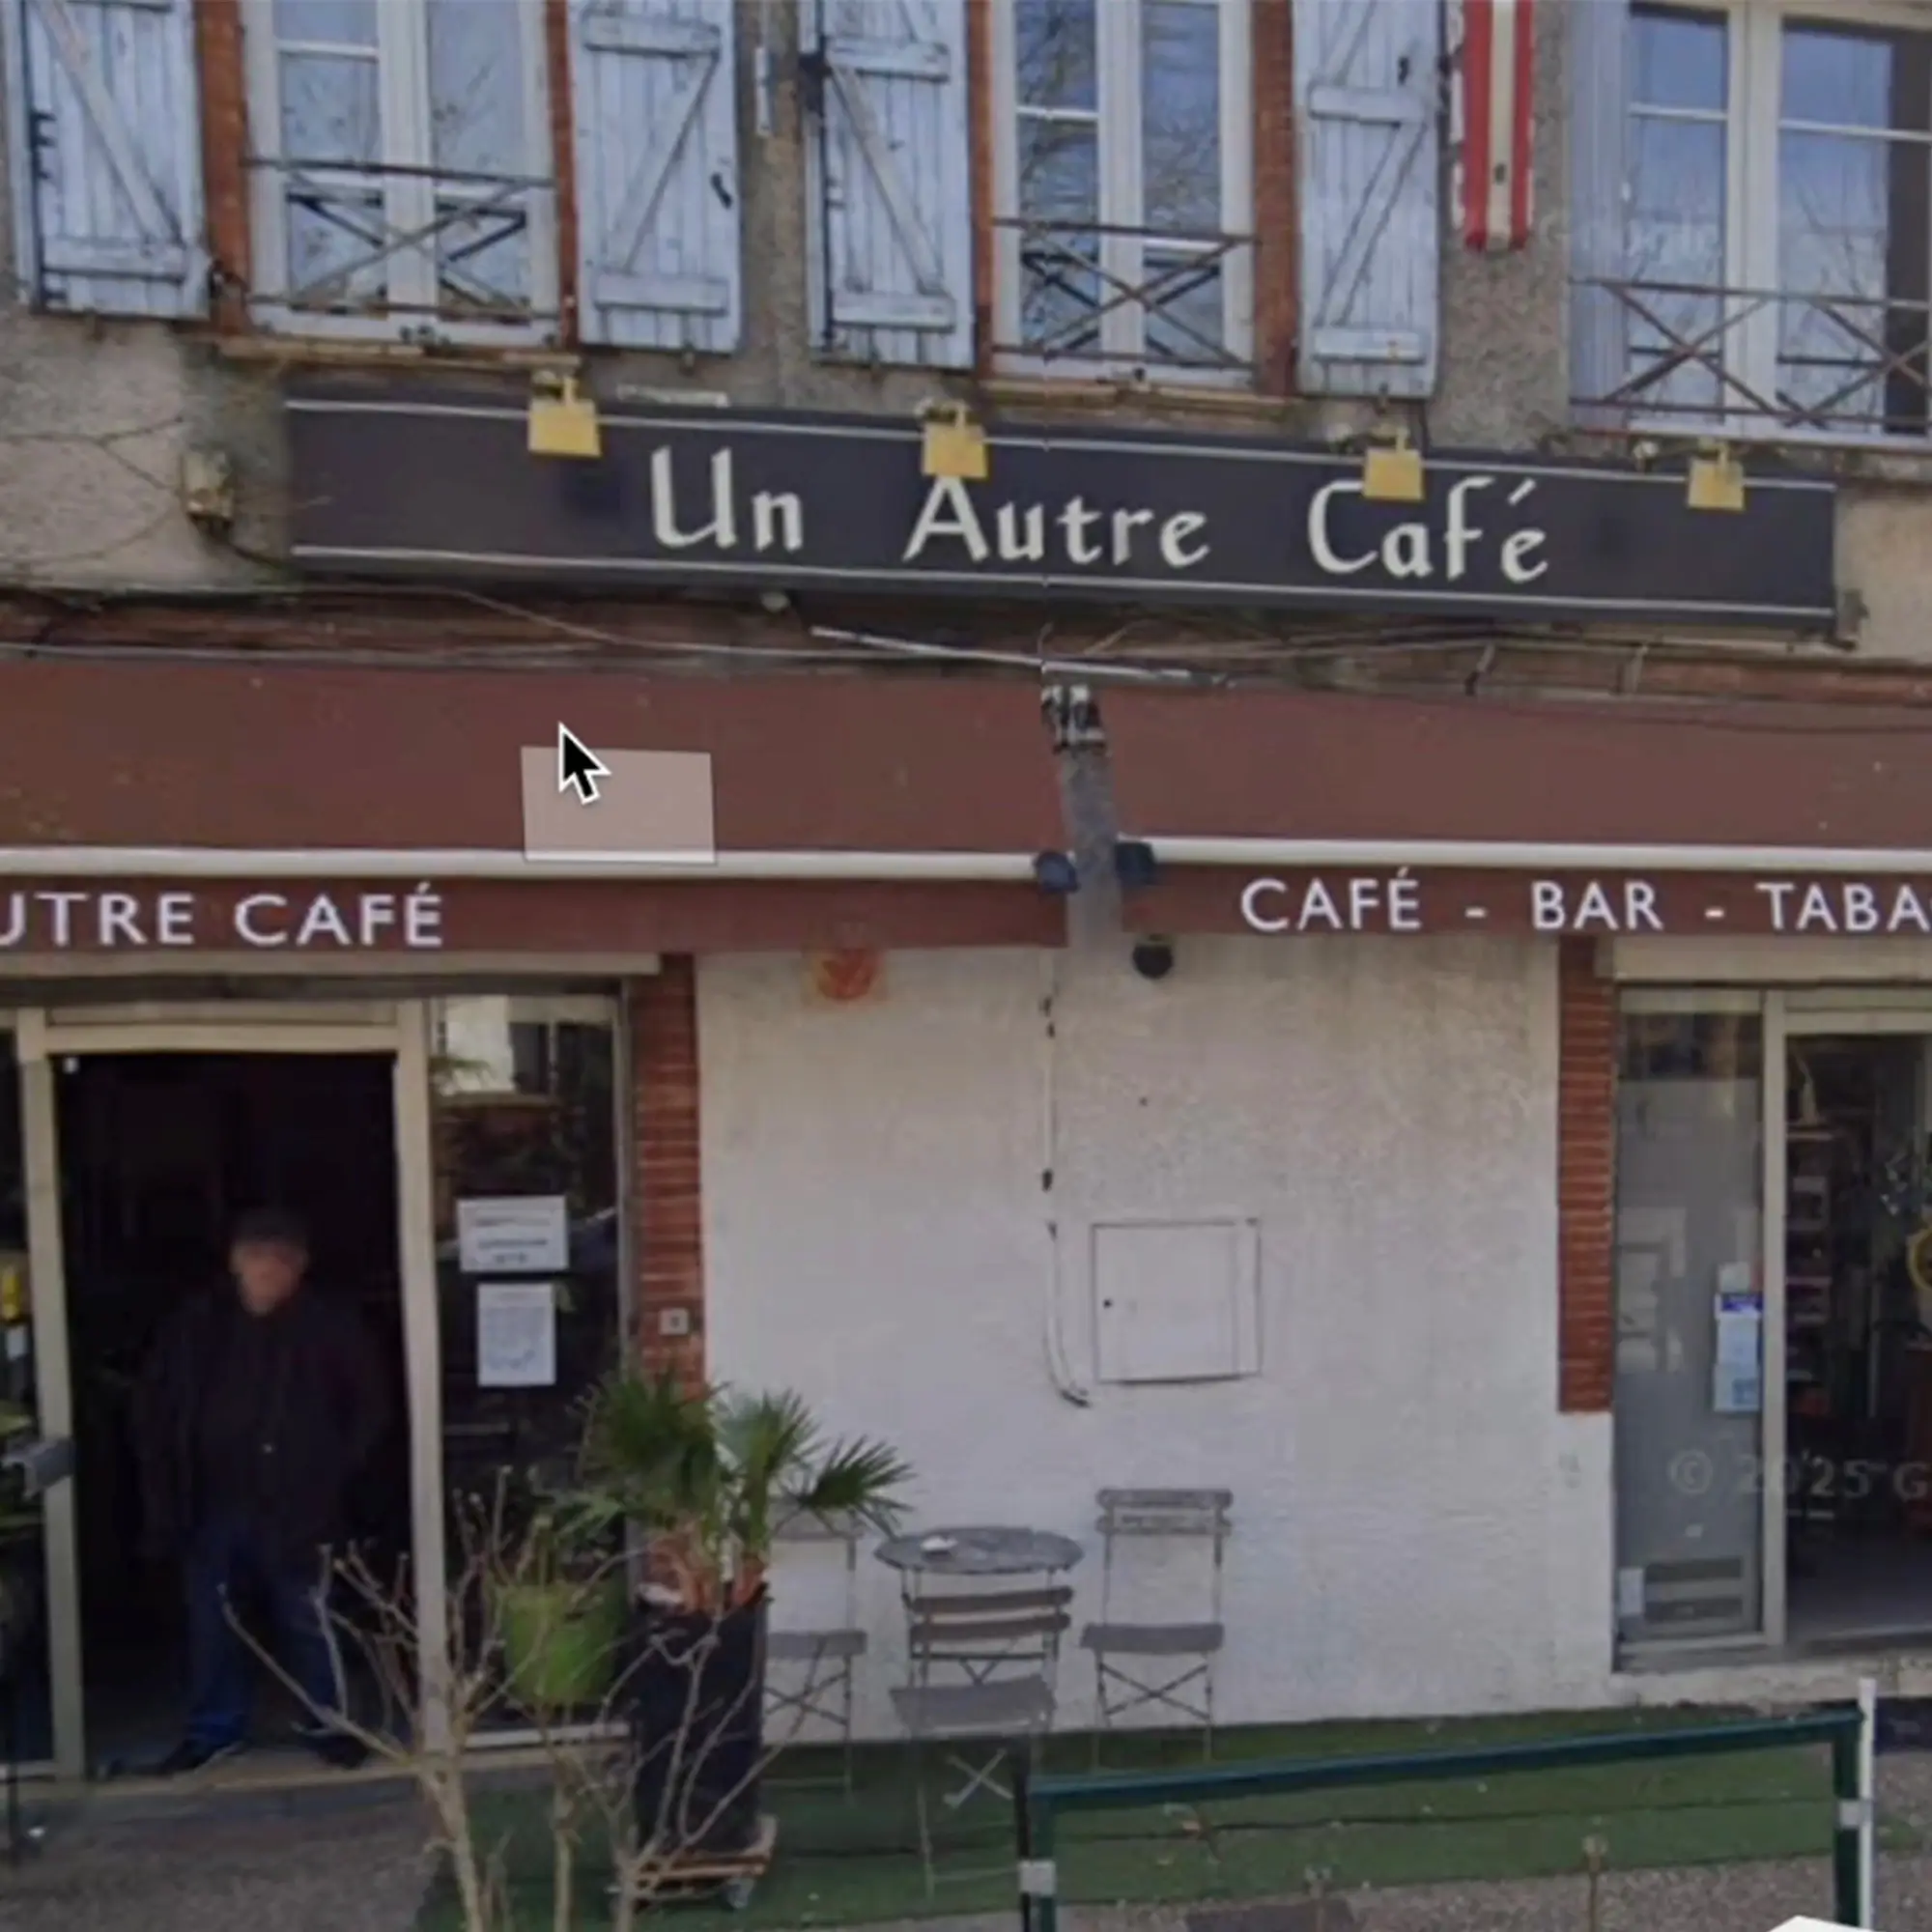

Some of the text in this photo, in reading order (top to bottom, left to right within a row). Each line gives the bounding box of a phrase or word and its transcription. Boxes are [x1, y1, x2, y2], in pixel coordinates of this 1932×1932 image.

[650, 446, 1548, 582] Un Autre Café
[234, 881, 442, 947] CAFÉ
[1240, 867, 1932, 932] CAFÉ - BAR - TABA
